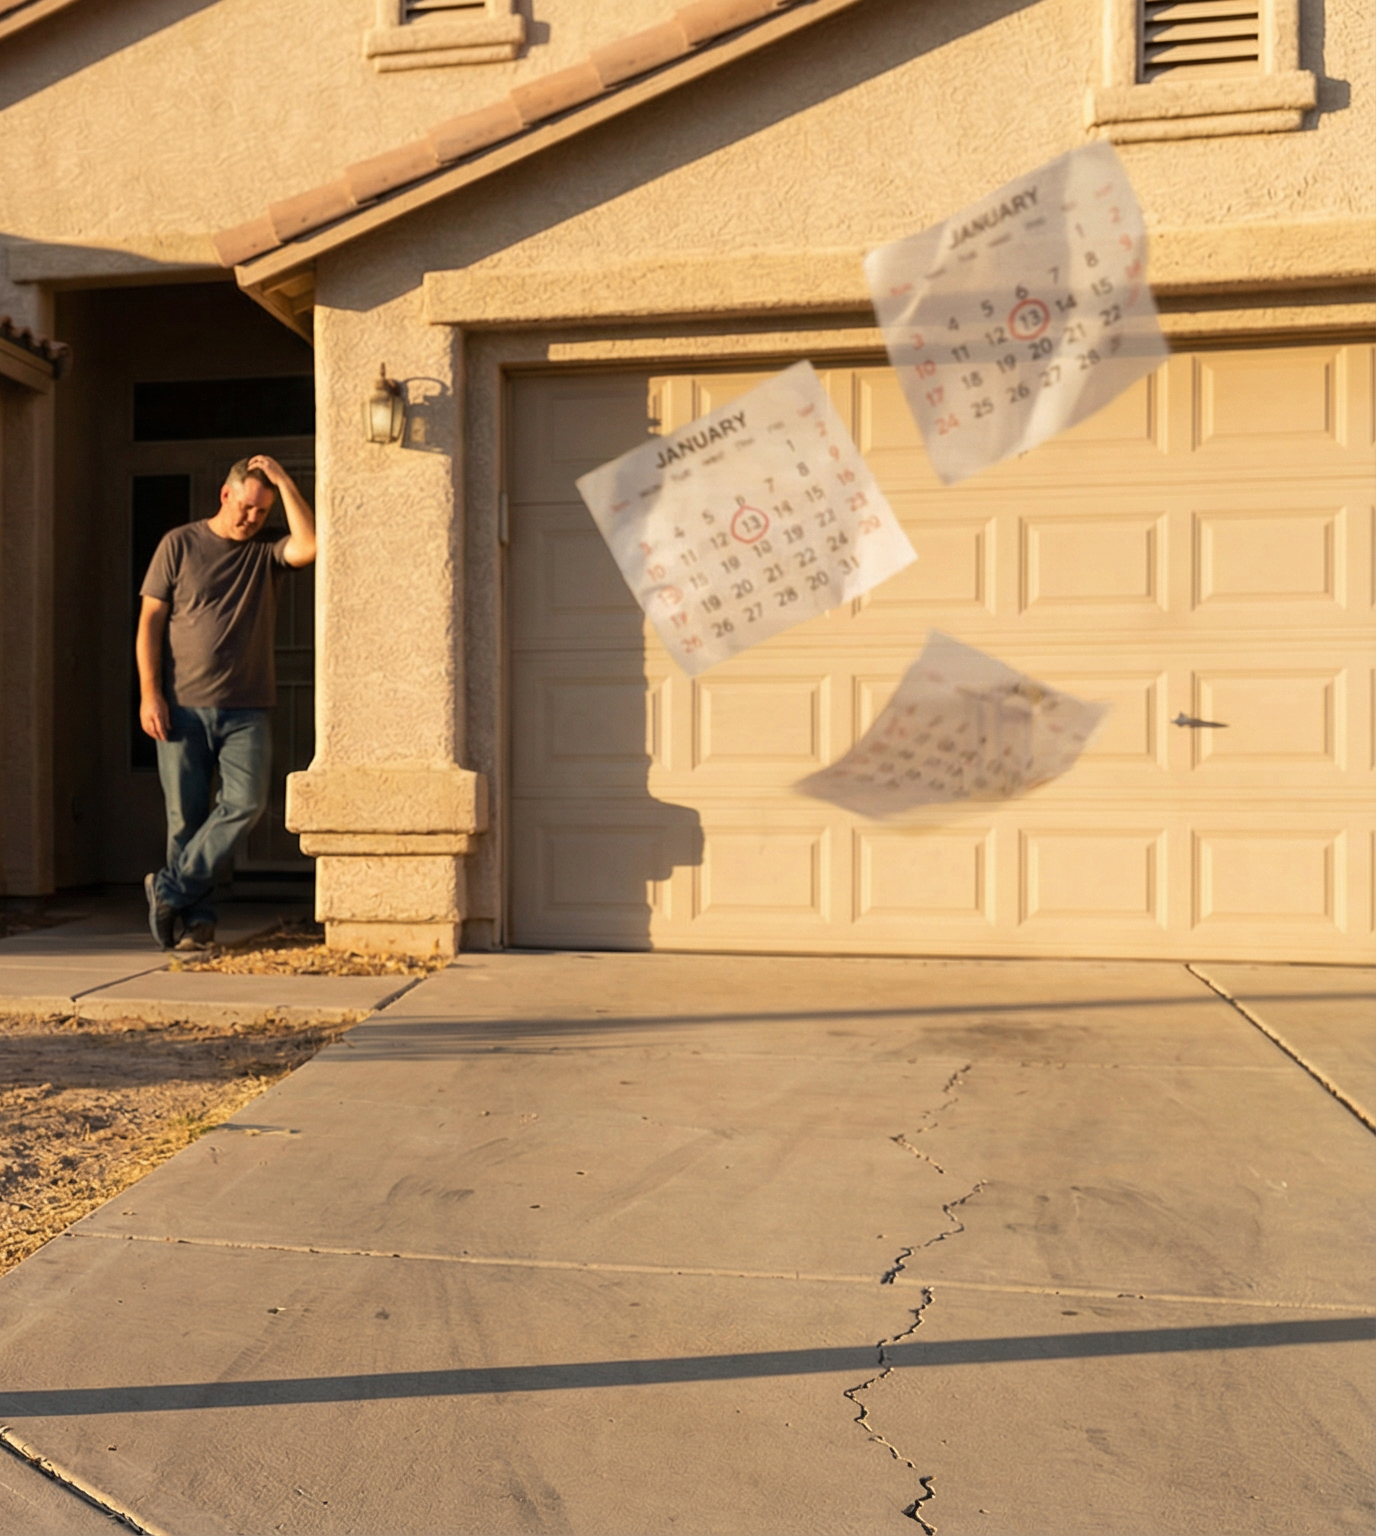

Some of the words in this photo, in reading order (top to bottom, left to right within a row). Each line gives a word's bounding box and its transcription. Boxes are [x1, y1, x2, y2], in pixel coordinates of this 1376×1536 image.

[949, 186, 1041, 251] JANUARY
[911, 333, 924, 350] 3
[981, 300, 994, 317] 5
[1016, 285, 1029, 300] 6
[1048, 267, 1060, 284] 7
[1084, 252, 1099, 268] 8
[916, 359, 937, 378] 10
[951, 345, 970, 363] 11
[985, 327, 1008, 346] 12
[1020, 309, 1042, 329] 13
[1055, 294, 1077, 313] 14
[1091, 278, 1114, 296] 15
[926, 387, 944, 407] 17
[962, 372, 983, 390] 18
[996, 353, 1017, 374] 19
[1028, 337, 1054, 359] 20
[1064, 322, 1087, 343] 21
[1100, 305, 1122, 327] 22
[935, 413, 960, 435] 24
[971, 397, 994, 418] 25
[1006, 381, 1030, 403] 26
[1039, 365, 1063, 387] 27
[1076, 349, 1101, 370] 28
[654, 411, 749, 469] JANUARY
[786, 440, 795, 452] 1
[647, 564, 667, 581] 10
[680, 550, 698, 566] 11
[710, 532, 729, 550] 12
[742, 515, 762, 532] 13
[805, 486, 825, 504] 15
[702, 510, 715, 525] 5
[764, 478, 775, 493] 7
[732, 579, 754, 599] 20
[763, 564, 784, 583] 21
[794, 548, 818, 569] 22
[742, 602, 764, 623] 27
[775, 587, 799, 608] 28
[838, 555, 860, 577] 31
